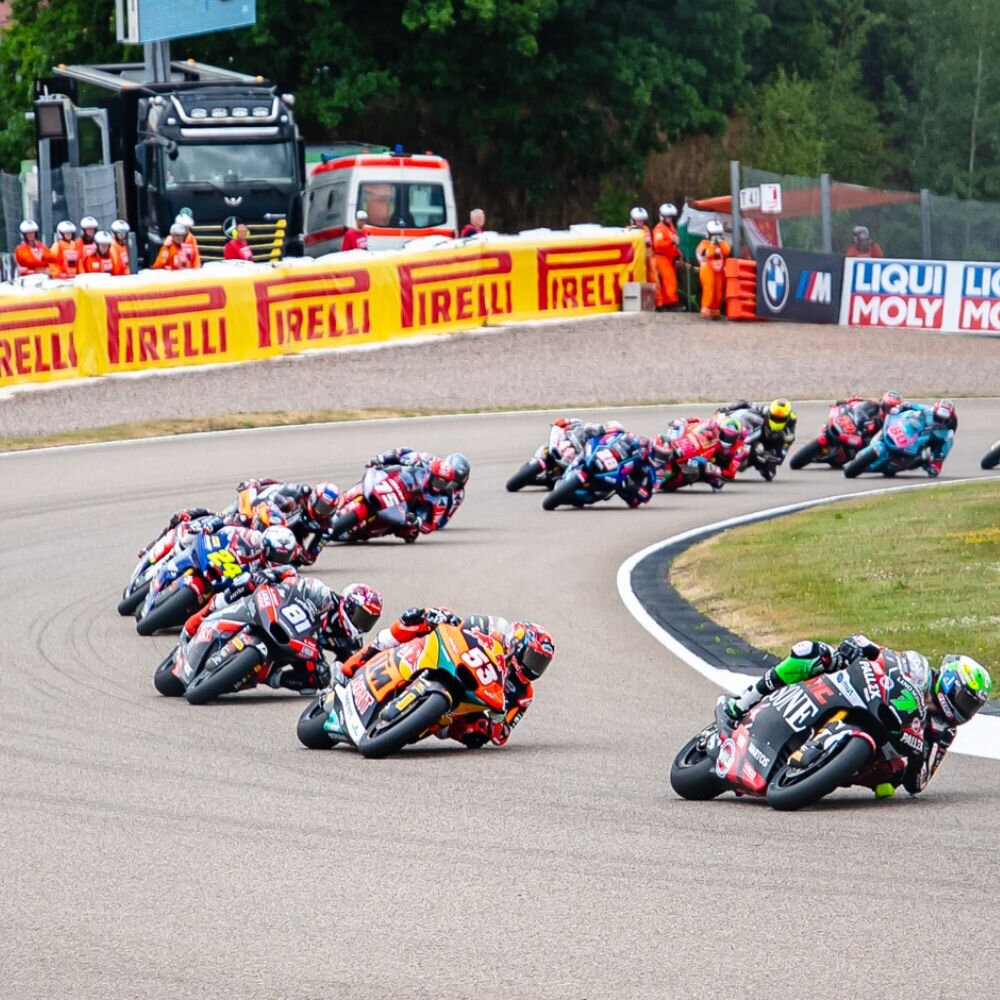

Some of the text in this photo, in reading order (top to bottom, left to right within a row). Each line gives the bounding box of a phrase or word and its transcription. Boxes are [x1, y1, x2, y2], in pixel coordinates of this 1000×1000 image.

[398, 252, 512, 328] PIRELLI
[855, 262, 943, 294] LIQUI
[104, 285, 227, 364] PIRELLI
[254, 269, 370, 348] PIRELLI
[852, 295, 942, 327] MOLY
[207, 549, 242, 578] 24
[281, 603, 312, 634] 81
[461, 648, 497, 685] 53
[890, 689, 918, 713] 7
